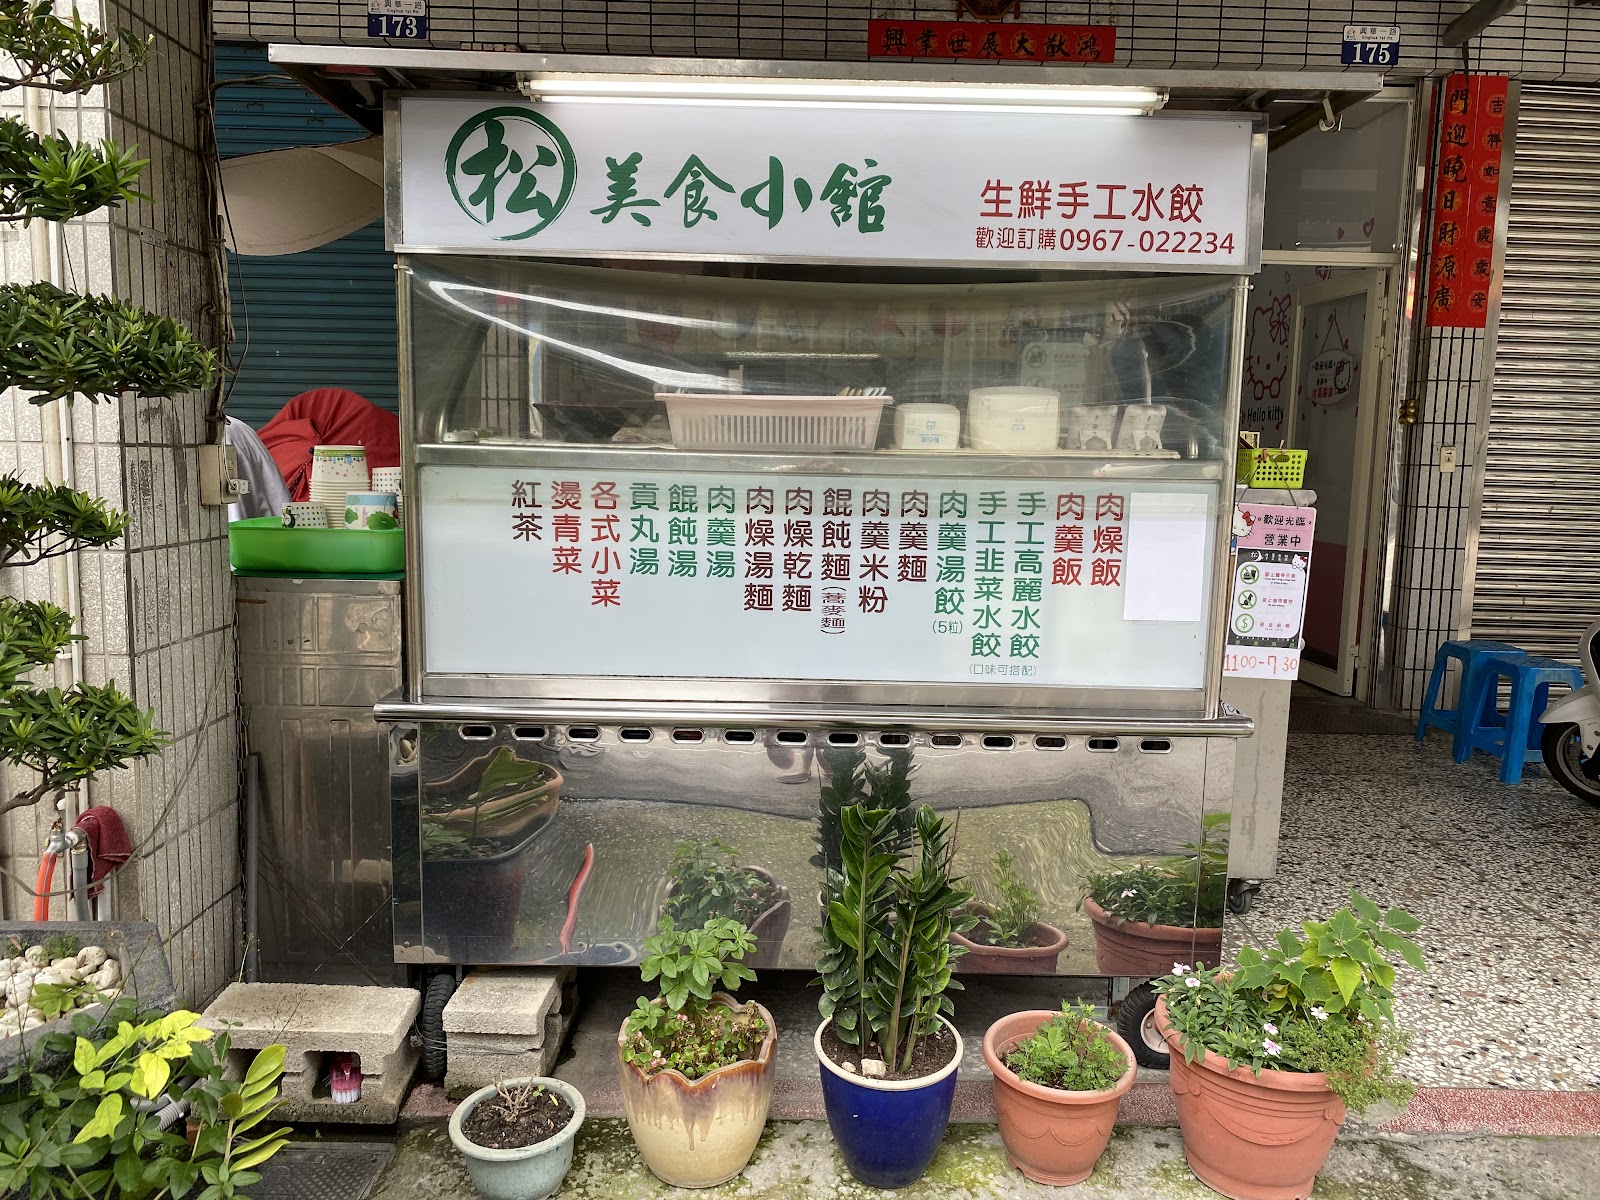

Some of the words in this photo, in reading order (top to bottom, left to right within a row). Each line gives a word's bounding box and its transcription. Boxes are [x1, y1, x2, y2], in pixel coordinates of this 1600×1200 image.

[379, 16, 417, 37] 173
[1353, 43, 1390, 63] 175
[458, 116, 560, 227] 松
[589, 152, 892, 234] 美食小館
[980, 179, 1203, 223] 生鮮手工水餃
[1432, 88, 1469, 312] 門迎曉日財源廣
[1471, 97, 1504, 308] 吉祥如意歲歲安
[1248, 407, 1265, 422] Hello
[1268, 406, 1284, 424] kitty
[511, 479, 542, 542] 紅茶
[551, 480, 582, 575] 燙青菜
[590, 481, 621, 608] 各式小菜
[629, 482, 660, 575] 貢丸湯
[668, 483, 698, 578] 餛飩湯
[706, 485, 736, 579] 肉羹湯
[743, 486, 775, 611] 肉燥湯麵
[782, 486, 813, 612] 肉燥乾麵
[820, 487, 852, 581] 餛飩麵
[858, 489, 890, 614] 肉羹米粉
[897, 489, 929, 583] 肉羹麵
[934, 490, 968, 616] 肉羹湯餃
[1051, 492, 1085, 586] 肉羹飯
[1090, 492, 1125, 587] 肉燥飯
[1263, 514, 1306, 527] 歡迎光臨
[1264, 534, 1301, 547] 營業中
[970, 491, 1007, 658] 手工韭菜水餃
[1009, 491, 1047, 659] 手工高麗水餃
[932, 620, 963, 635] (5粒)
[969, 664, 1037, 677] (口味可搭配)
